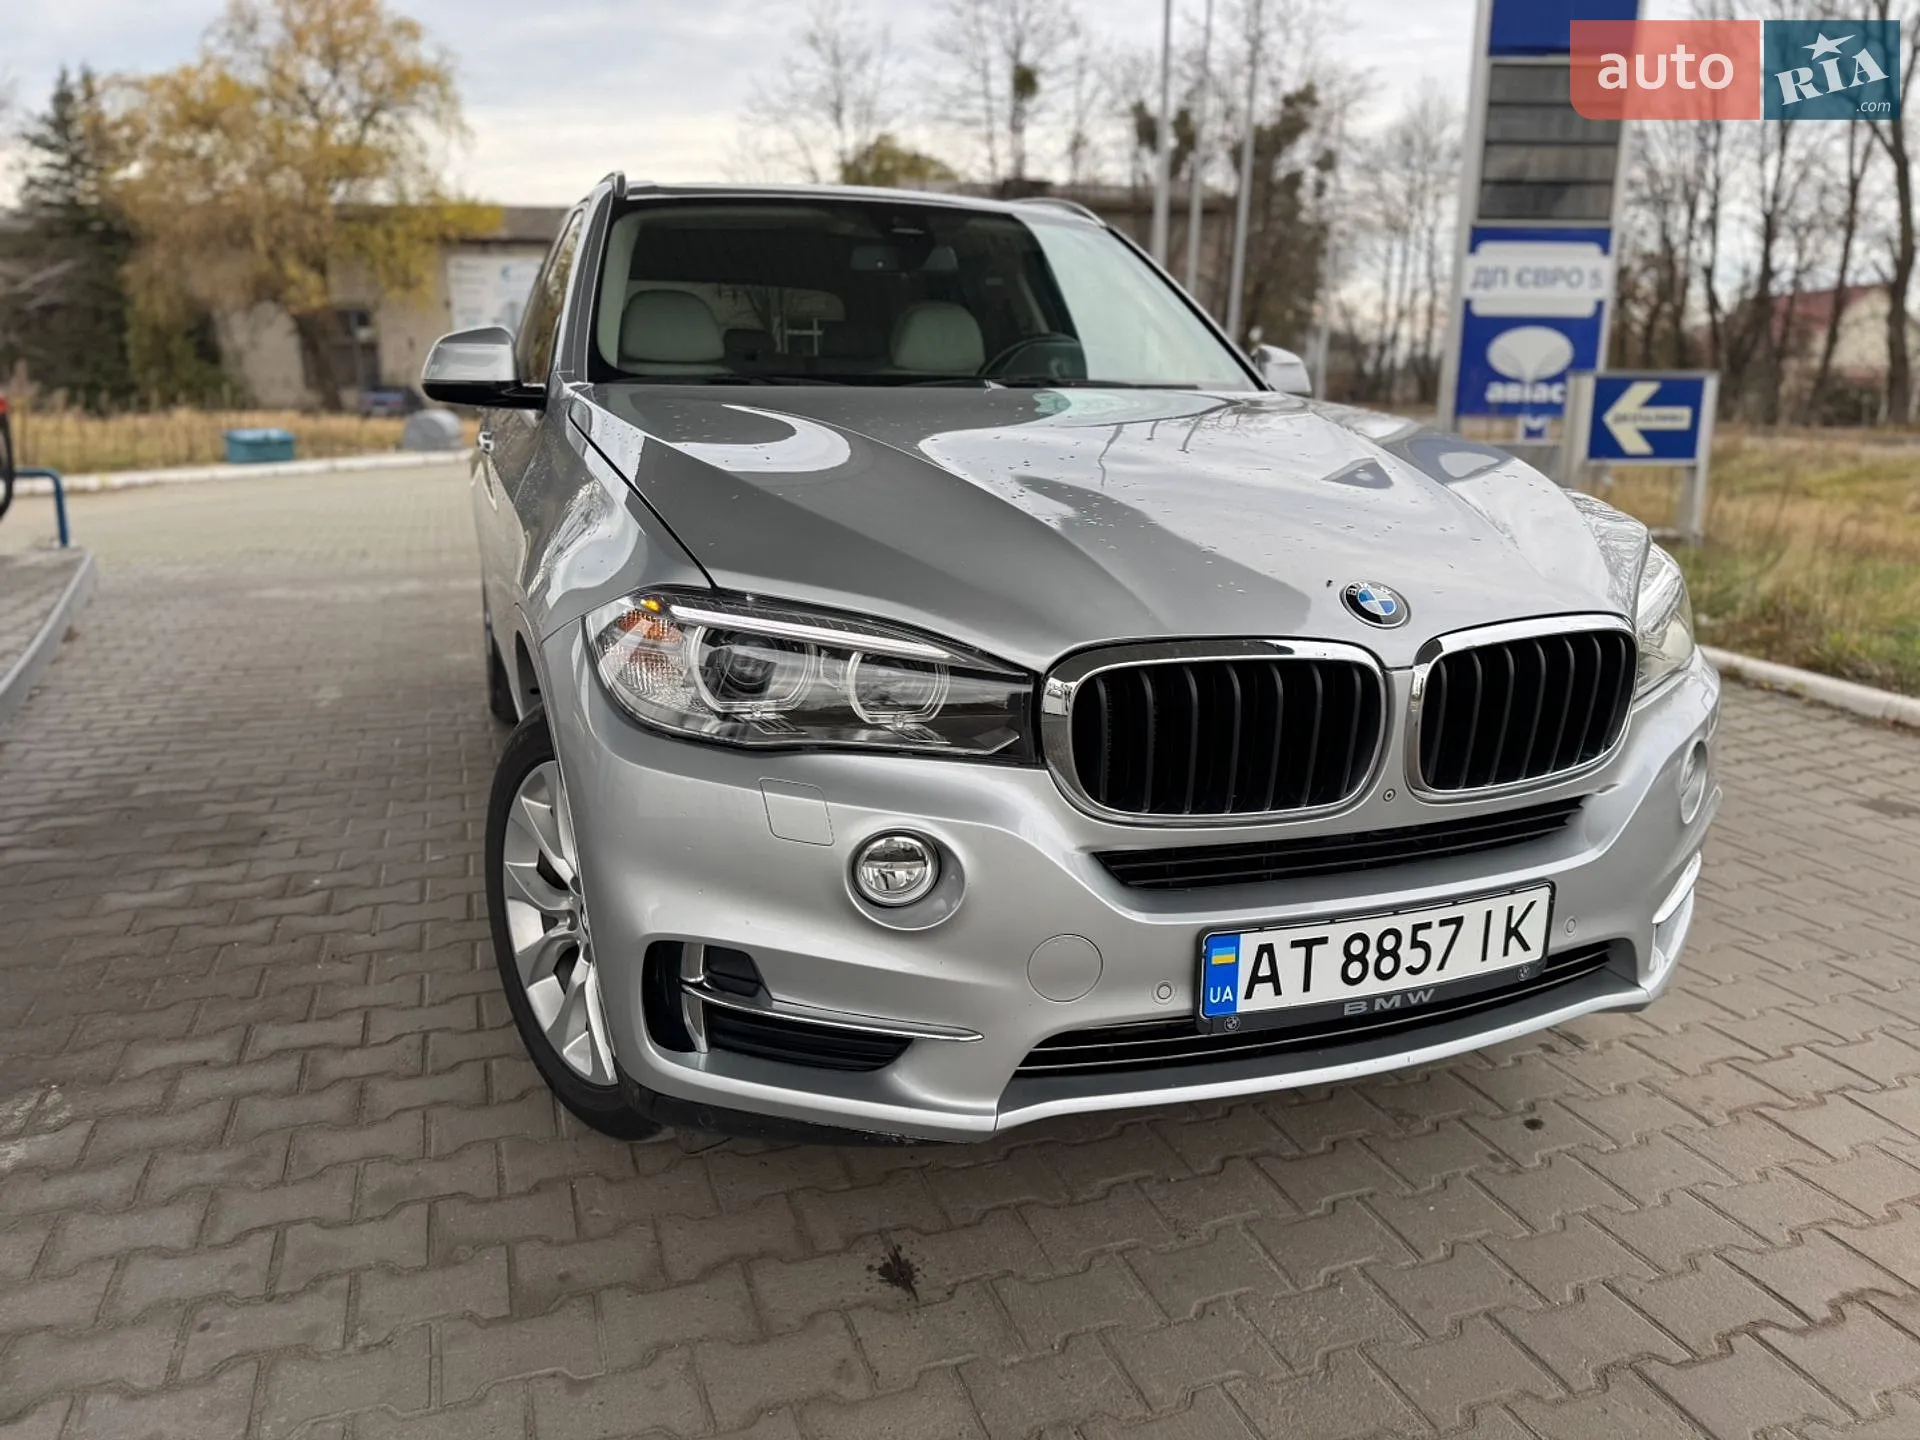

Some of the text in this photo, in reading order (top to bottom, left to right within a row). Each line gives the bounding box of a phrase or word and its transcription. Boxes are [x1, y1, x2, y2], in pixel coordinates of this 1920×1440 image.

[1244, 900, 1537, 1000] AT 8857 IK
[1209, 985, 1234, 1004] UA
[1343, 988, 1436, 1016] BMW
